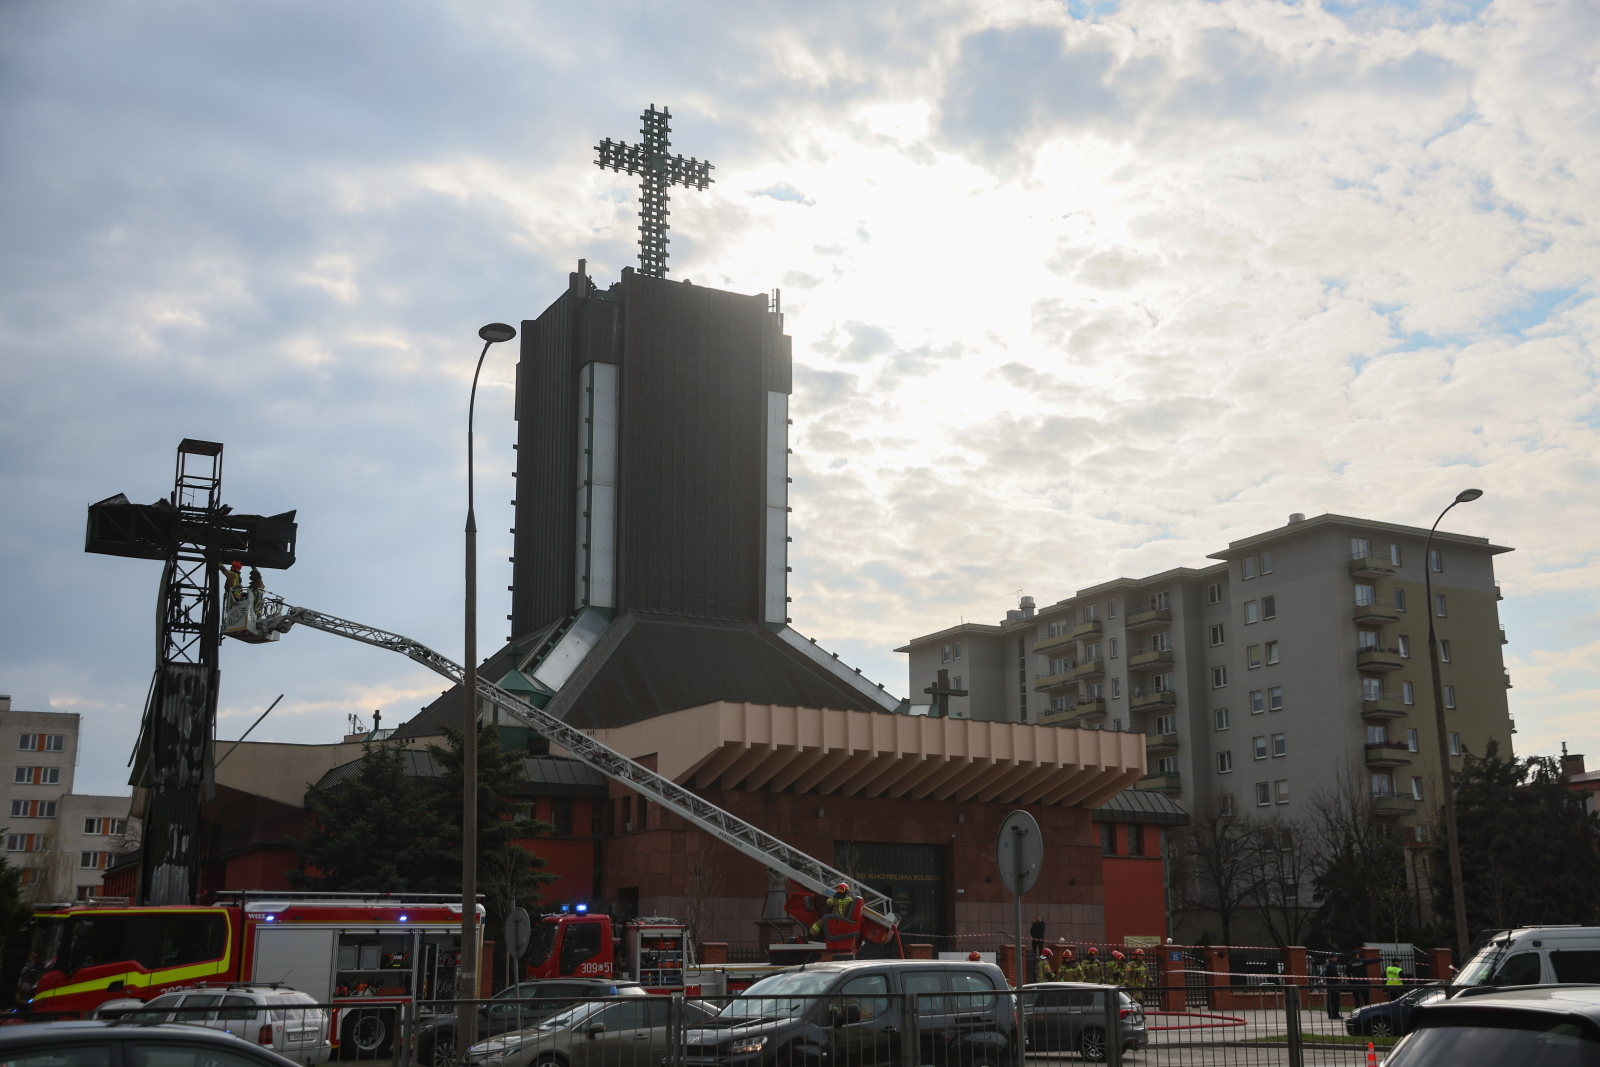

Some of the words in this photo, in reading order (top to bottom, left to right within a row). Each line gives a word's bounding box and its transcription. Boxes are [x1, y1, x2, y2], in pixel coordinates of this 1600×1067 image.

[718, 831, 743, 848] MAGIRUS
[913, 874, 942, 882] KOLBEGO
[1172, 953, 1179, 961] 35
